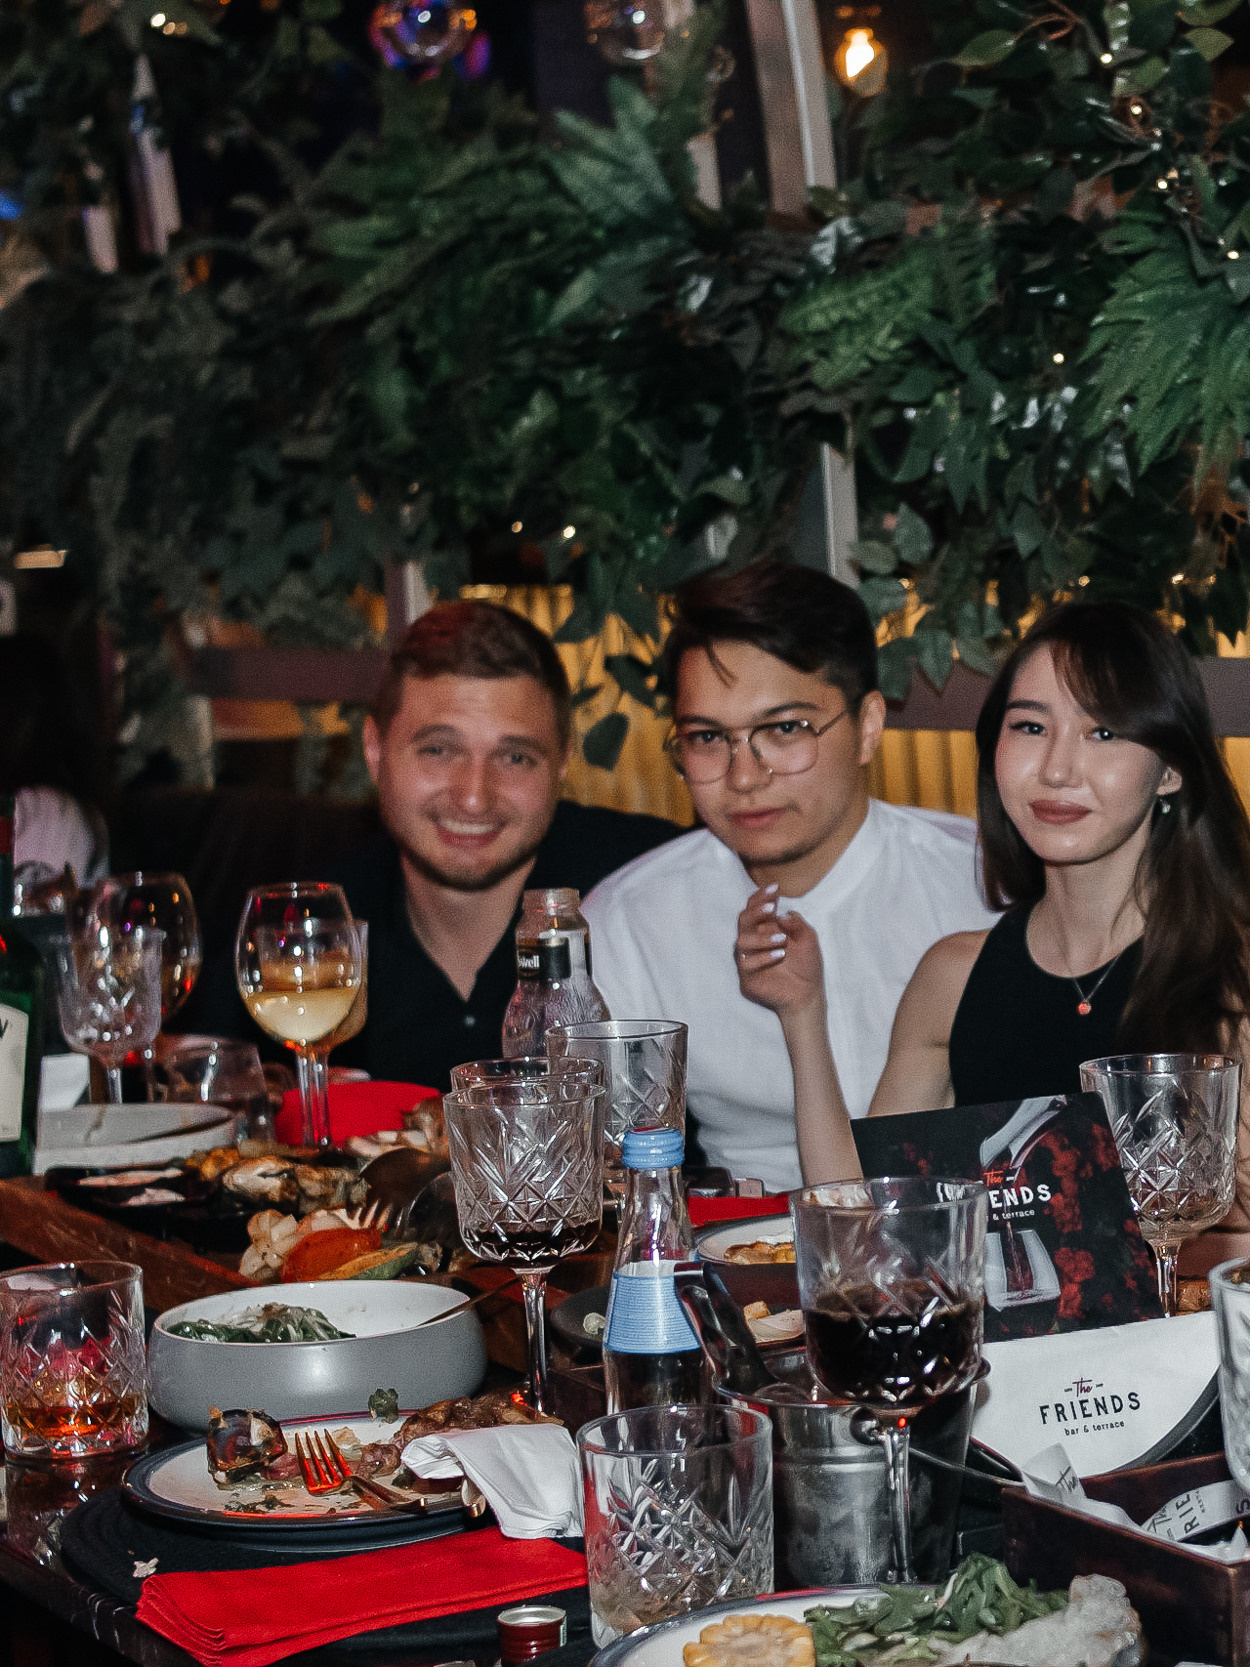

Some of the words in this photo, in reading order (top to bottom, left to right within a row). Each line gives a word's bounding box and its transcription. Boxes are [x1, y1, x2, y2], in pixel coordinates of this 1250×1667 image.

[984, 1170, 1004, 1188] The
[1002, 1209, 1035, 1220] terrace
[1072, 1377, 1093, 1398] The
[1039, 1392, 1141, 1425] FRIENDS
[1064, 1427, 1080, 1436] bar
[1083, 1425, 1090, 1433] &
[1093, 1421, 1125, 1432] terrace
